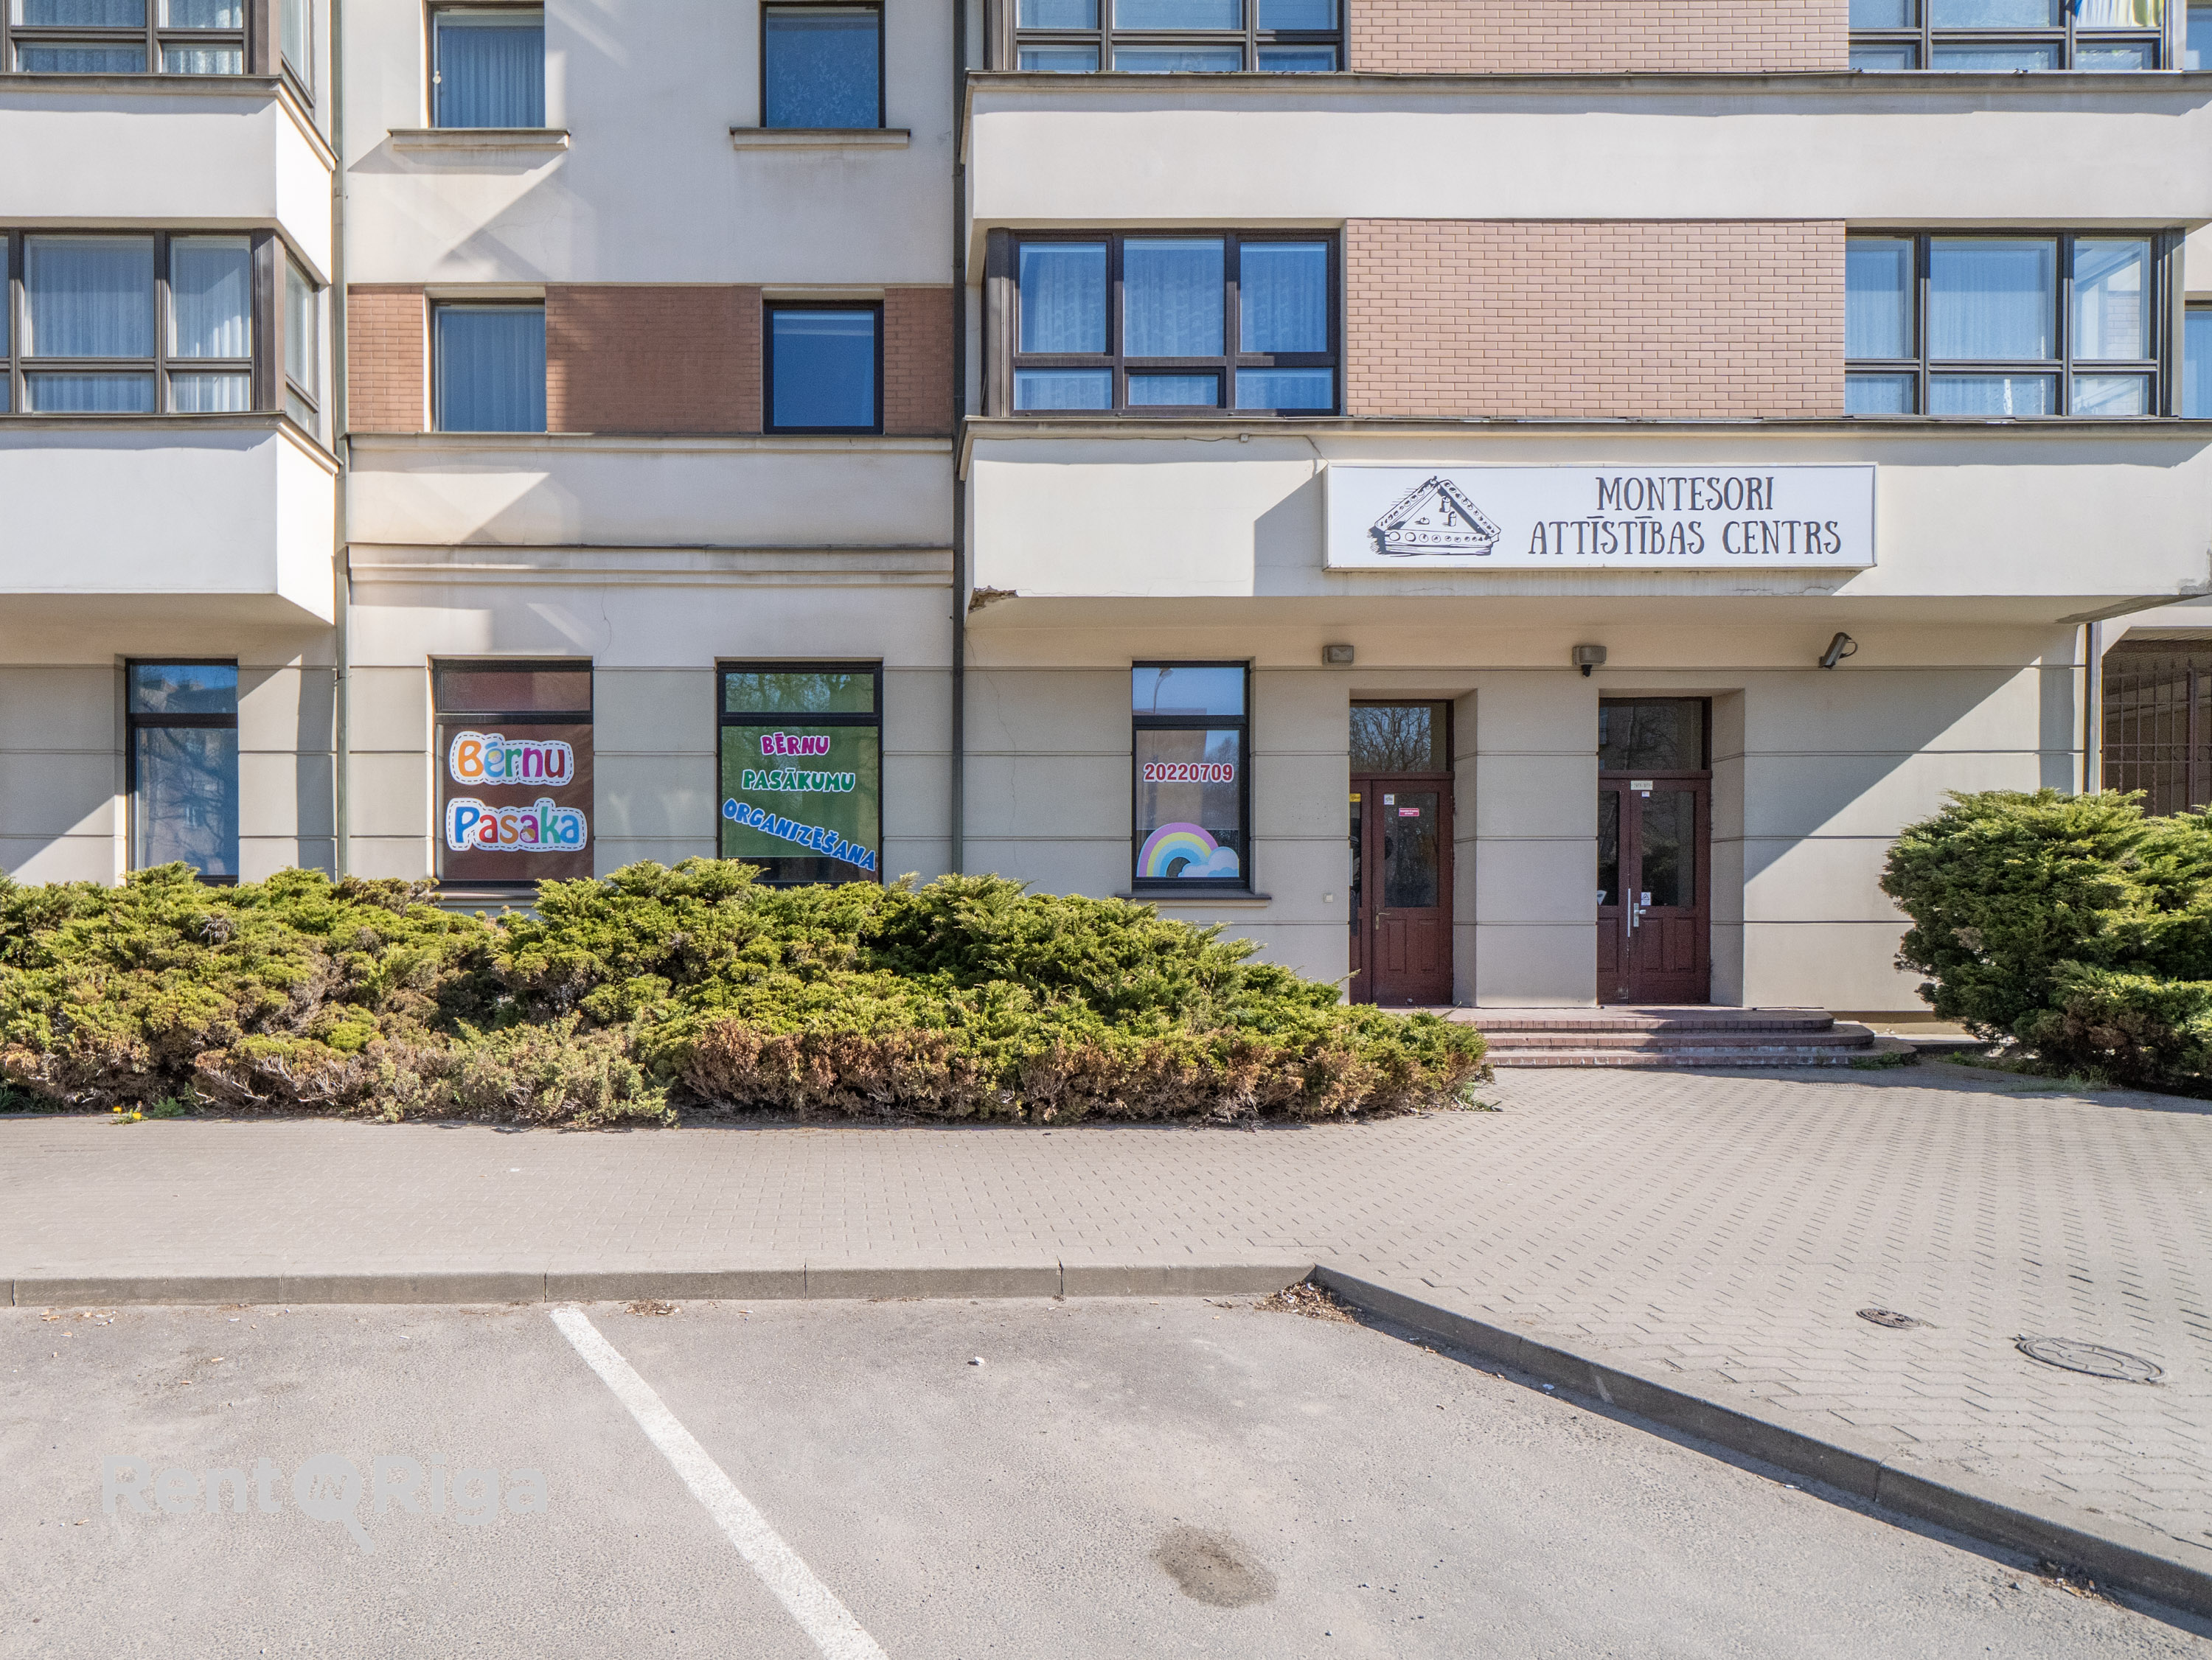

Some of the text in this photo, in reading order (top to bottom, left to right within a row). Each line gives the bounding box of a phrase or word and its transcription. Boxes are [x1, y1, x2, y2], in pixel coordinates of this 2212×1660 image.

[1595, 476, 1775, 511] MONTESORI
[1528, 515, 1842, 555] ATTĪSTĪBAS CENTRS
[458, 739, 566, 778] Bērnu
[761, 733, 830, 756] BĒRNU
[742, 768, 855, 792] PASĀKUMU
[1144, 764, 1233, 781] 20220709
[454, 806, 580, 844] Pasaka
[723, 798, 876, 871] ORGANIZĒŠANA
